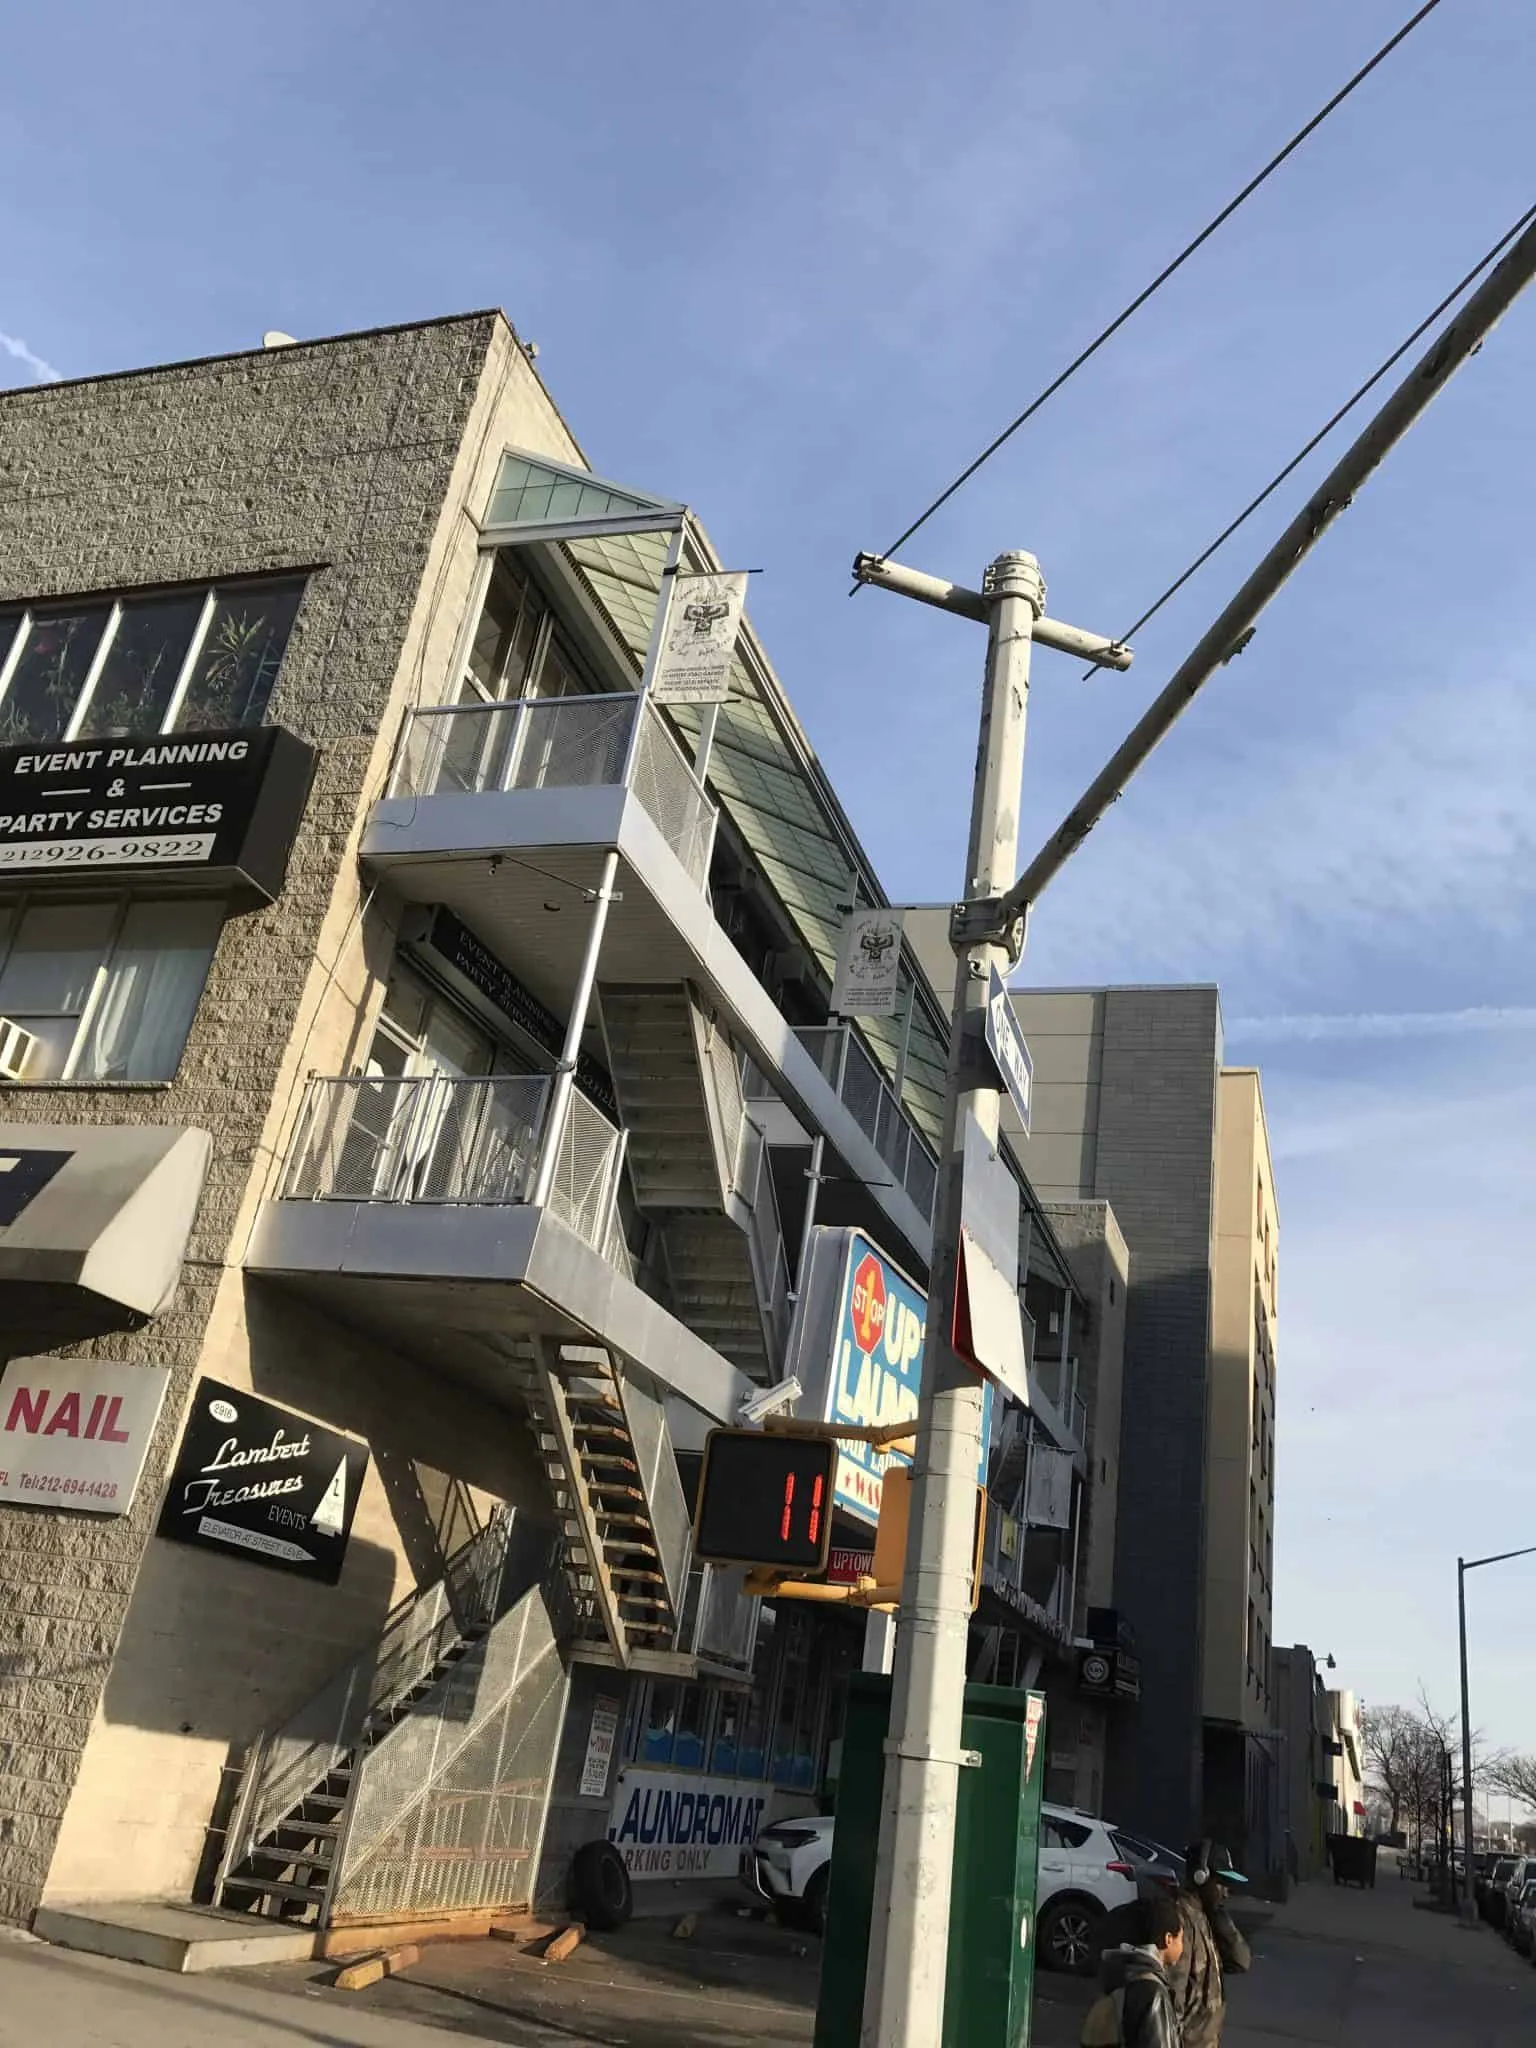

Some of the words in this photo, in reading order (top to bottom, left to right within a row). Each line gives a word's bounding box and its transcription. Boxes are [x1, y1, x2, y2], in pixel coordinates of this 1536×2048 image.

[14, 751, 102, 774] EVENT
[106, 741, 249, 767] PLANNING
[106, 778, 125, 798] &
[0, 811, 83, 834] PARTY
[87, 803, 223, 829] SERVICES
[884, 1291, 926, 1375] UP
[5, 1387, 130, 1442] NAIL
[201, 1429, 311, 1472] Lambert
[183, 1475, 304, 1514] Treasures
[781, 1472, 823, 1544] 11
[268, 1505, 307, 1530] EVENTS
[833, 1552, 873, 1572] UPTOW
[608, 1787, 765, 1845] AUNDROMAT
[625, 1850, 671, 1872] RKING
[676, 1850, 711, 1871] ONLY
